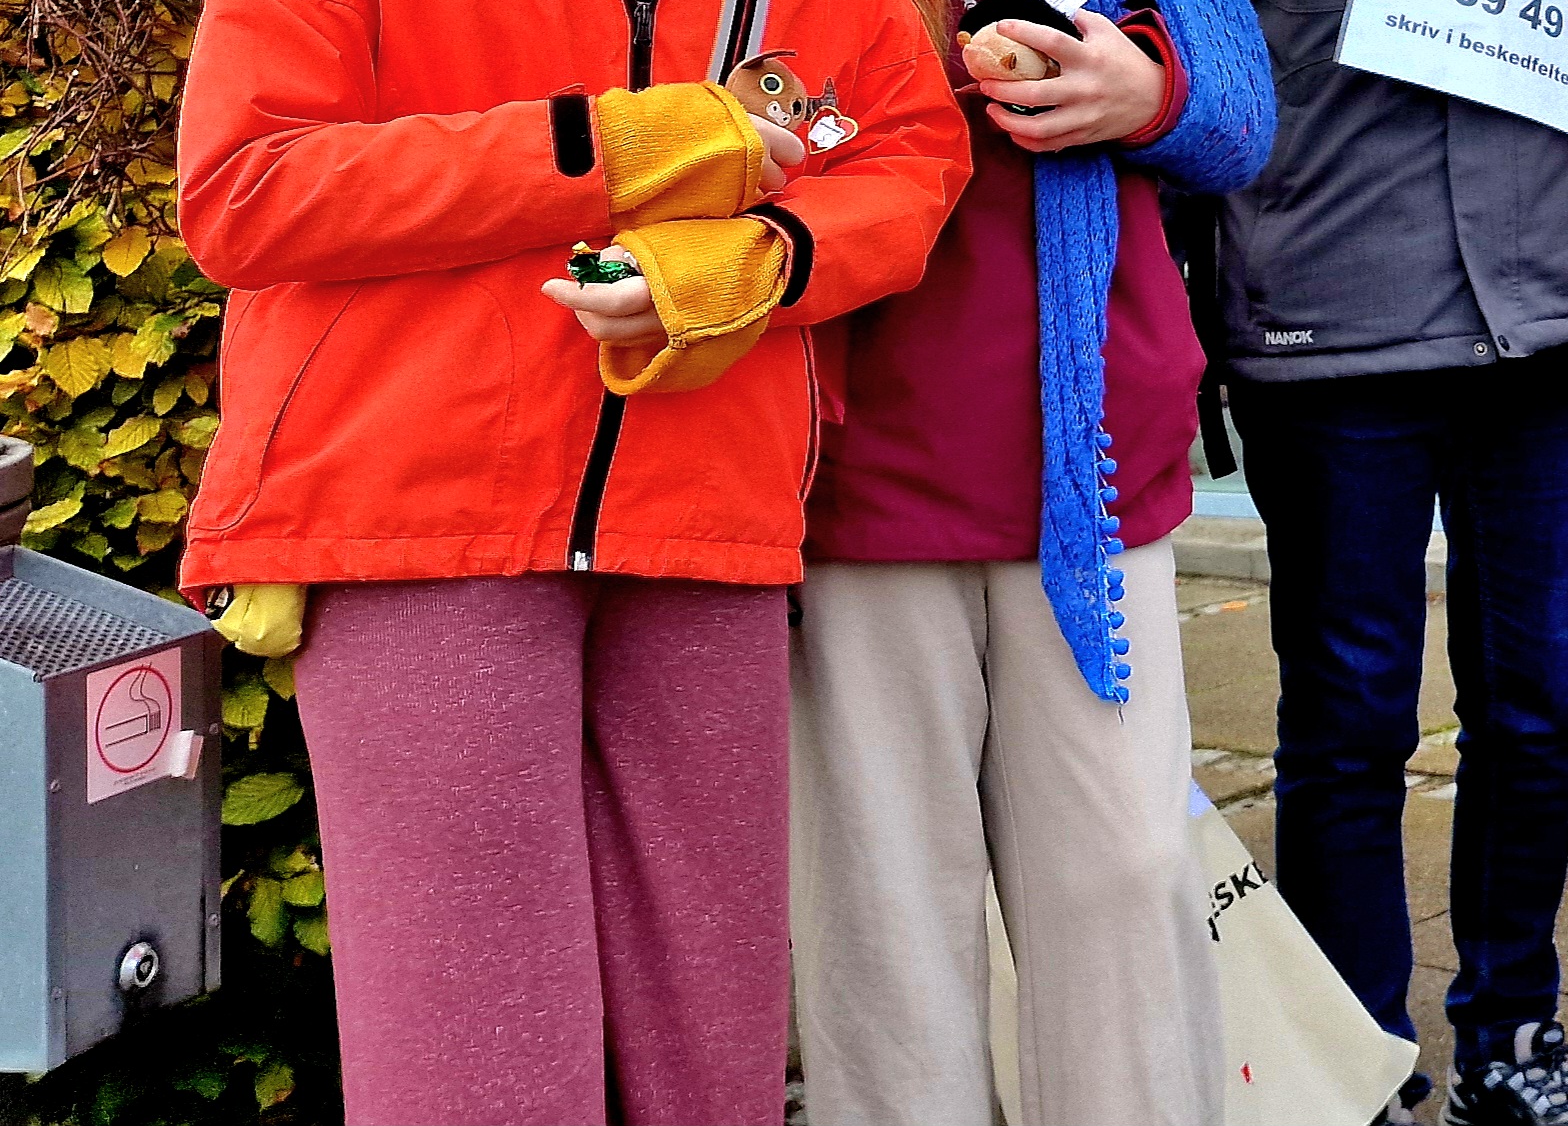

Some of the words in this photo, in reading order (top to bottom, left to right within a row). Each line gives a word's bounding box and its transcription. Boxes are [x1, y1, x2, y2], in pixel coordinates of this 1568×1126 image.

[1385, 11, 1442, 41] skriv
[1445, 27, 1455, 45] i
[1264, 329, 1314, 345] NANOK
